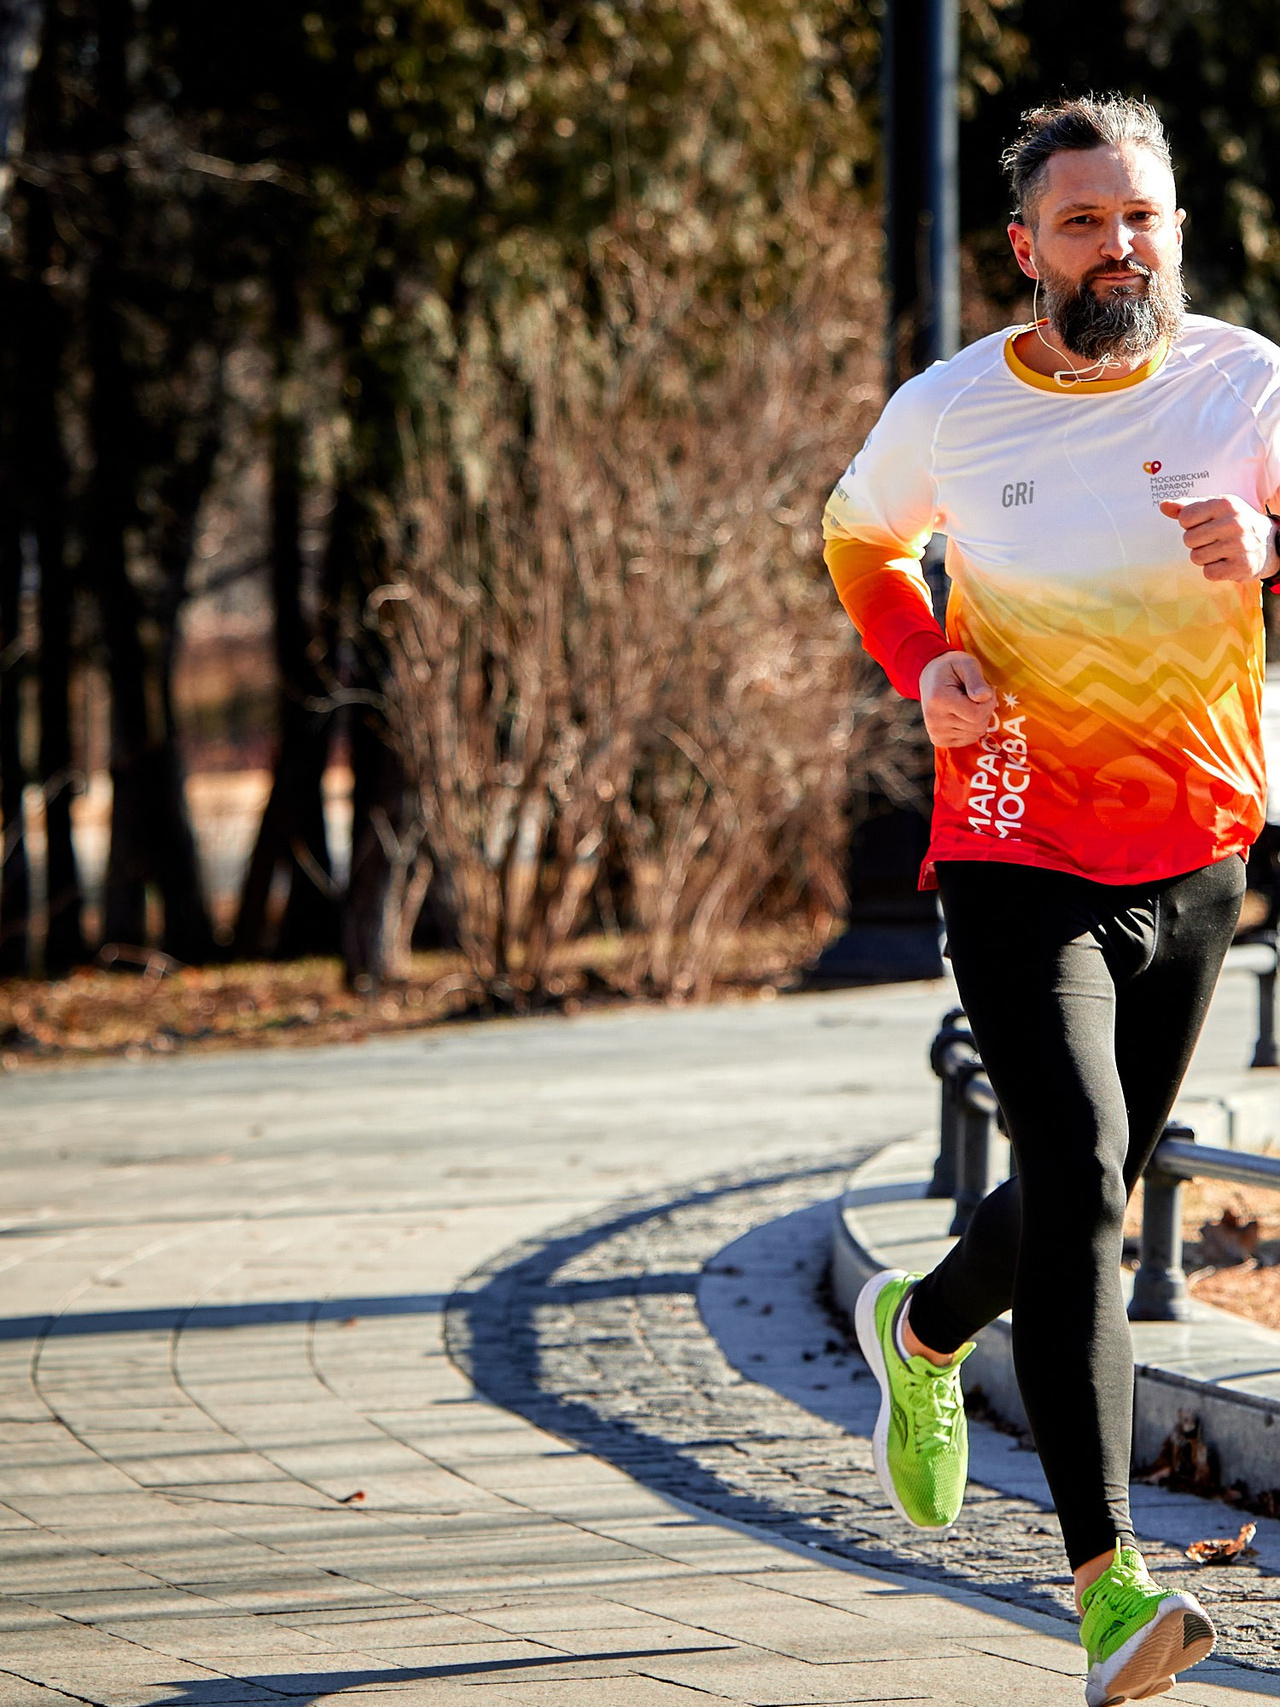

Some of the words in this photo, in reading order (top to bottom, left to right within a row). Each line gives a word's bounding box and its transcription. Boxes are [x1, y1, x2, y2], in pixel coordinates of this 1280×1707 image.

[1150, 471, 1210, 484] МОСКОВСКИЙ
[1151, 481, 1194, 492] МАРАФОН
[1152, 489, 1190, 499] MOSCOW
[995, 715, 1032, 842] МОСКВА
